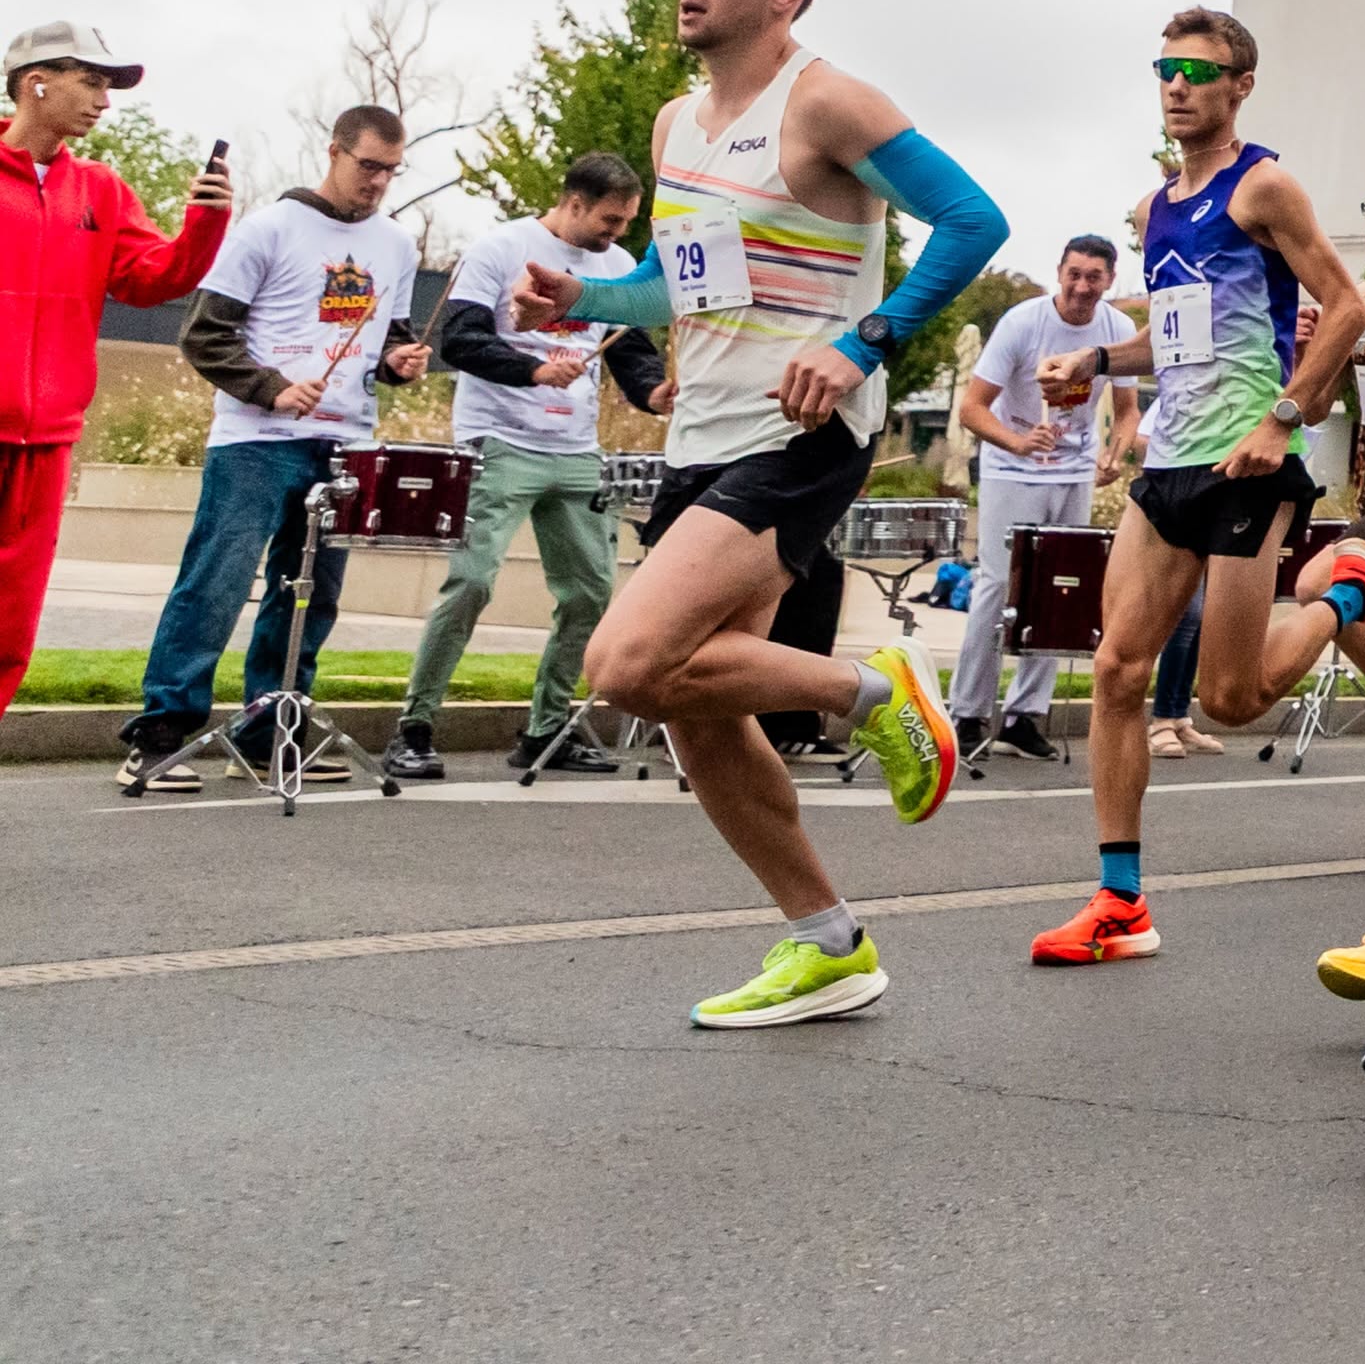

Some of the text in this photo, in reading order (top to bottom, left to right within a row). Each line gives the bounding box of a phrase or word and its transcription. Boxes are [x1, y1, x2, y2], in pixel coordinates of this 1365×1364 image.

[728, 136, 767, 155] HOKA
[676, 242, 706, 281] 29
[1163, 310, 1179, 340] 41
[898, 702, 939, 762] HOKA
